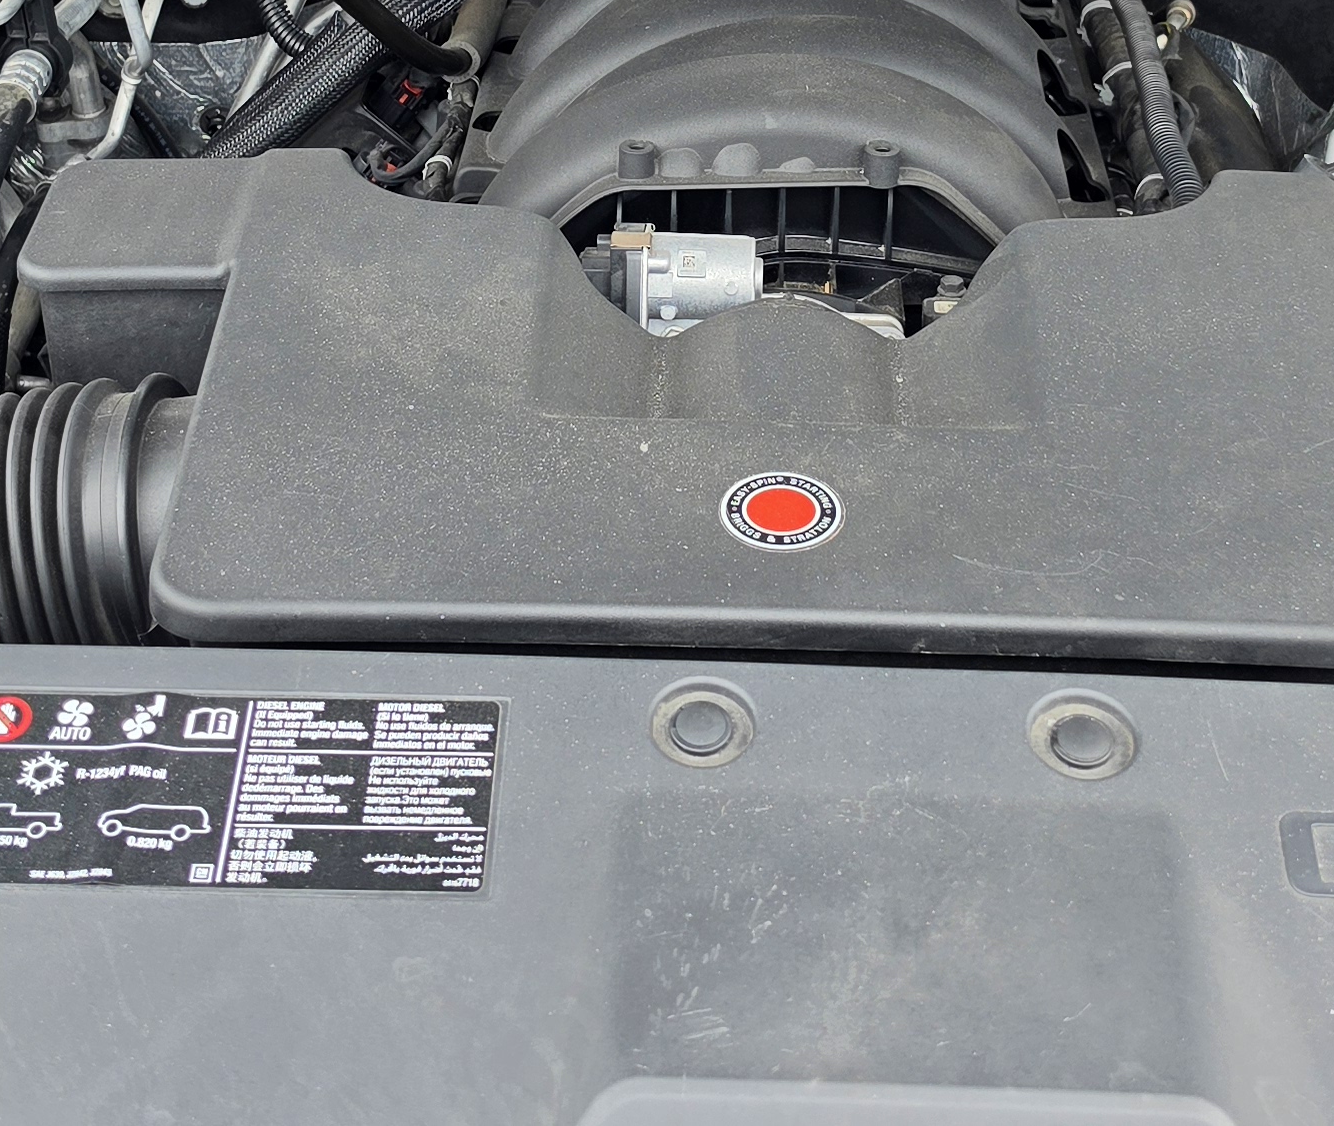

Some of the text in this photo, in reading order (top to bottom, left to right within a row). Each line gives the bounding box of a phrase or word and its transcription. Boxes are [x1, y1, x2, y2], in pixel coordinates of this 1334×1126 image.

[789, 477, 833, 509] STARTING
[730, 512, 832, 543] BRIGGS & STRATTON
[256, 701, 325, 711] DIESEL ENGINE
[377, 703, 445, 713] MOTOR DIESEL
[267, 711, 314, 720] Equipped)
[253, 720, 266, 728] Do
[267, 720, 283, 729] not
[301, 720, 337, 731] starting
[375, 722, 389, 731] No
[390, 722, 407, 731] use
[408, 722, 438, 731] fluidos
[439, 722, 452, 731] de
[48, 726, 92, 741] AUTO
[251, 729, 369, 741] Immediate engine damage
[374, 730, 387, 739] Se
[388, 731, 422, 741] pueden
[422, 731, 461, 741] producir
[249, 738, 267, 747] can
[423, 741, 436, 750] en
[436, 741, 446, 750] el
[247, 754, 322, 765] MOTEUR DIESEL
[369, 756, 489, 767] ДИЗЕЛЬНЫЙ ДВИГАТЕЛЬ
[76, 764, 167, 780] R-1234yf PAG oil
[243, 774, 257, 783] Ne
[258, 775, 275, 784] pas
[309, 775, 322, 784] de
[368, 776, 382, 785] Не
[305, 784, 326, 793] Des
[239, 793, 291, 804] dommages
[237, 804, 348, 814] au moteur pourraient en
[233, 828, 294, 840] 柴油发动机
[13, 836, 28, 849] kg
[126, 835, 173, 851] 0.820 kg
[228, 860, 313, 874] 否则会立即损坏
[225, 872, 268, 884] 发动机。
